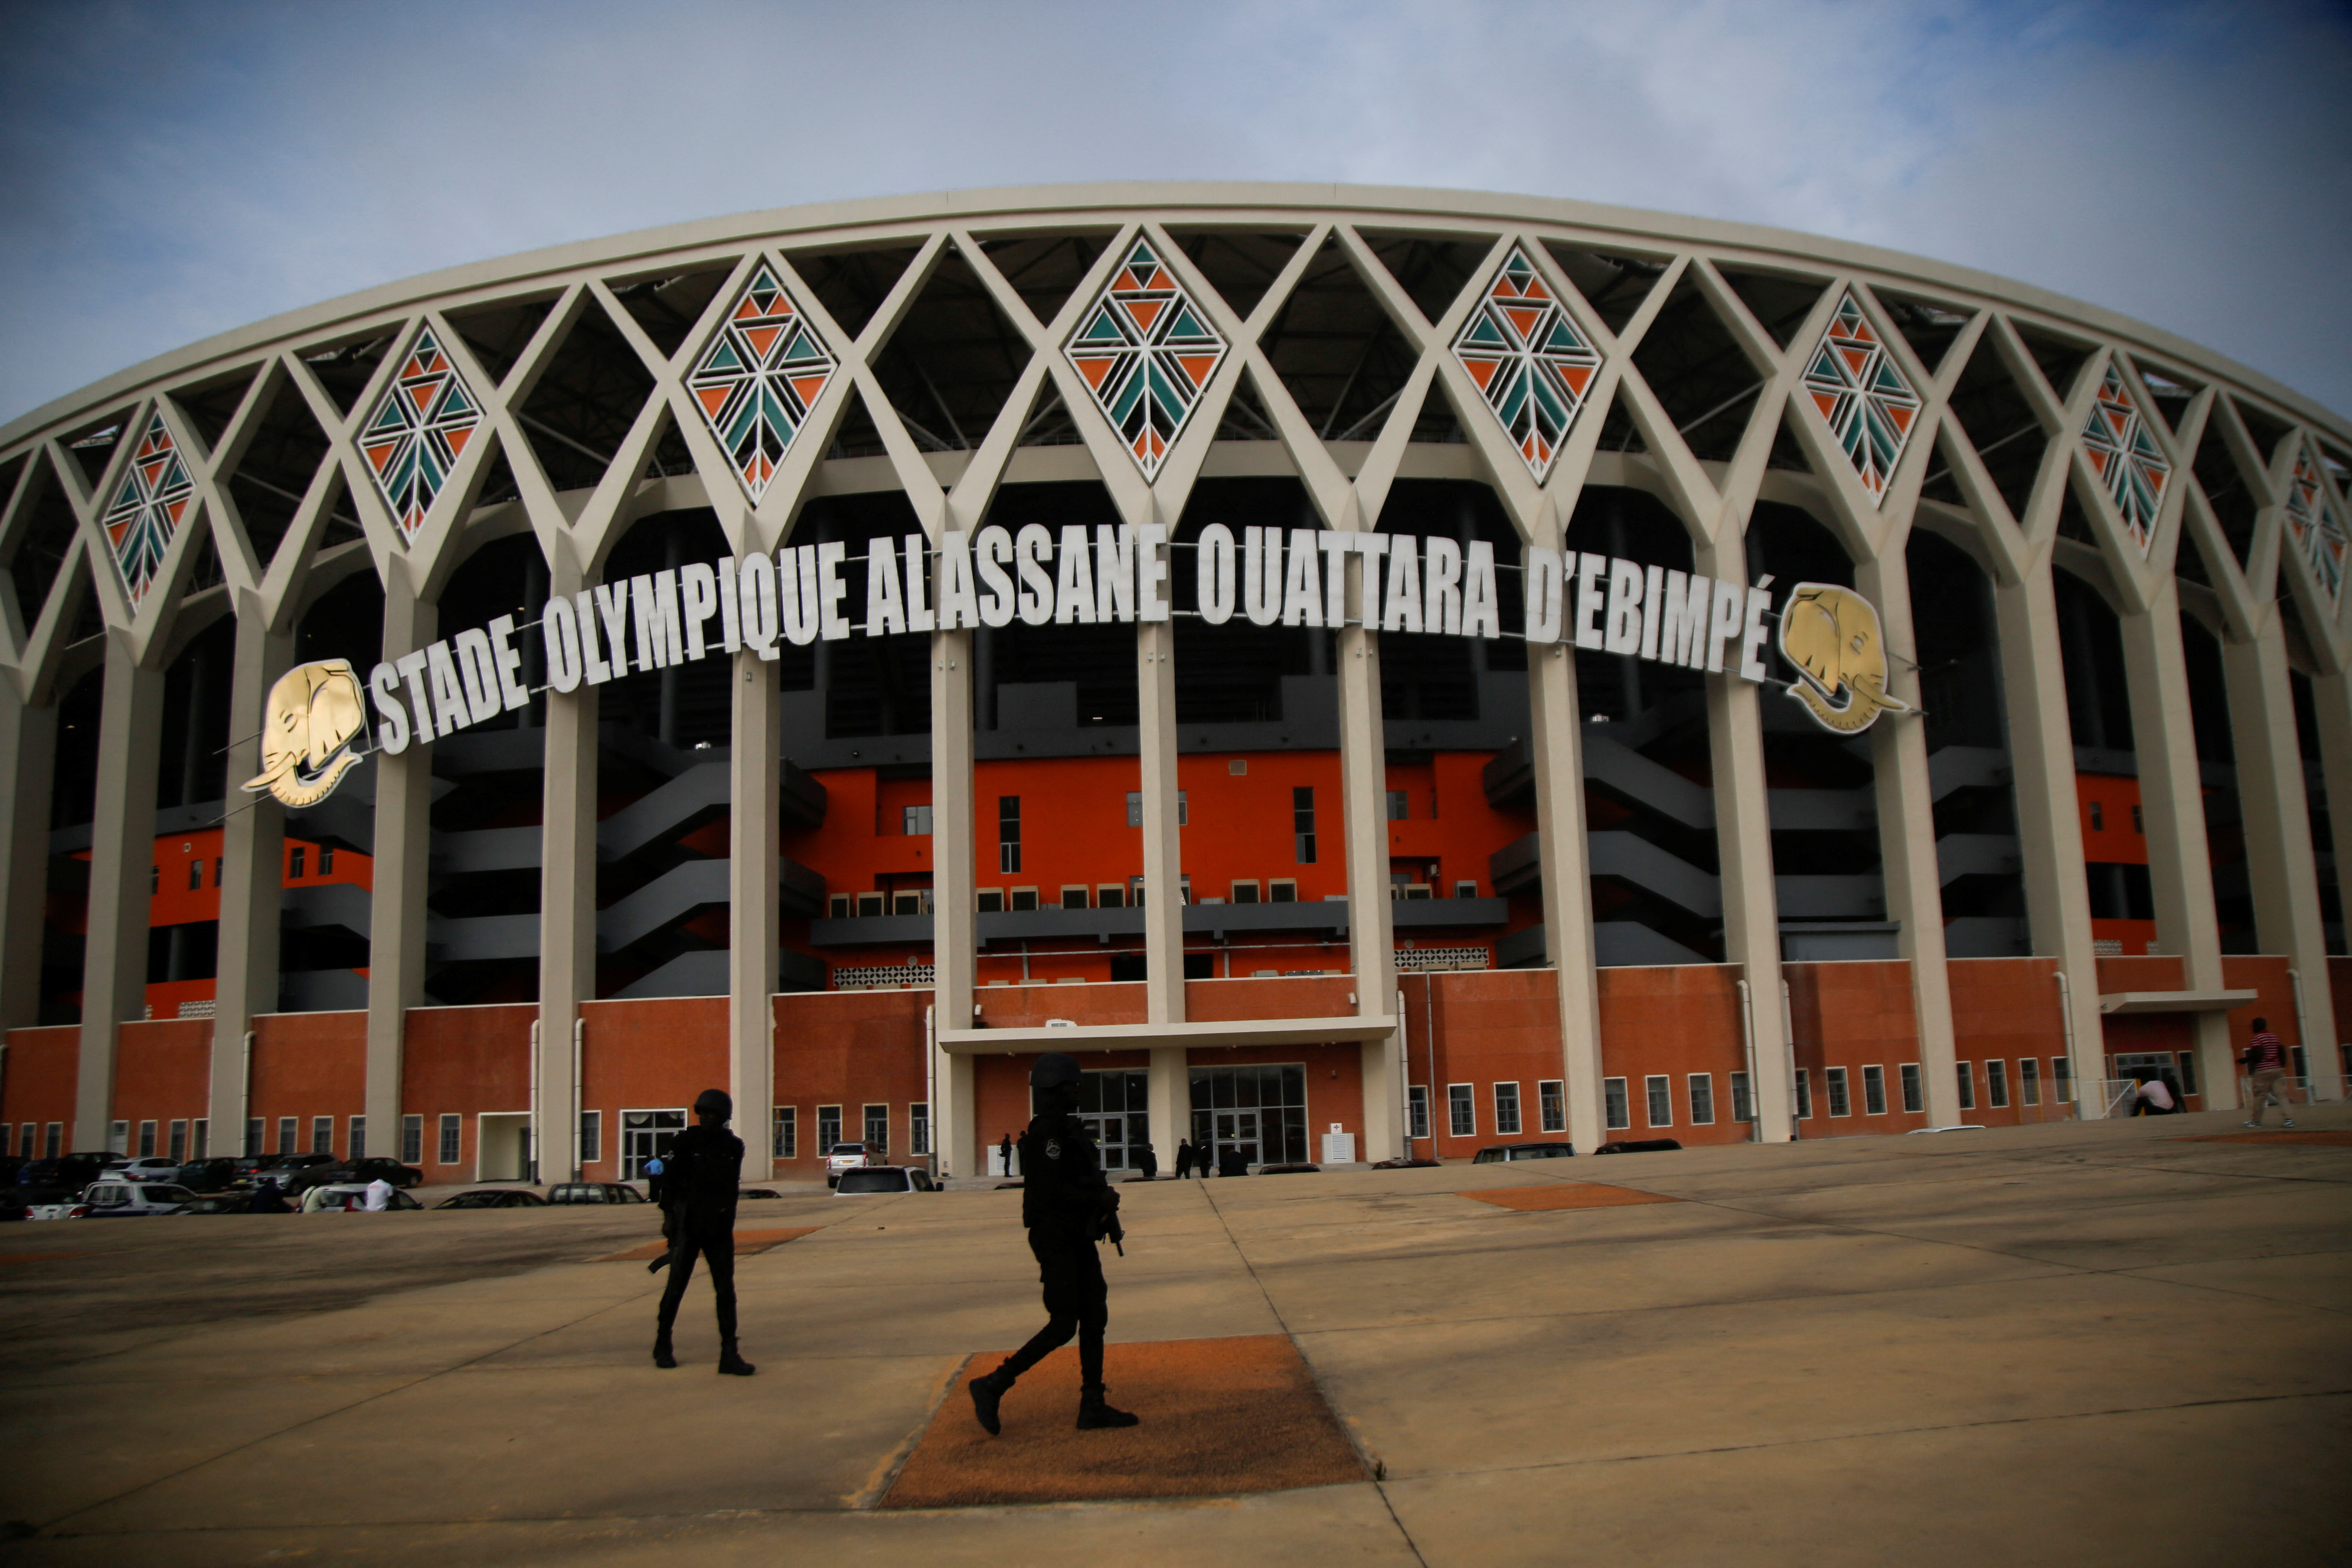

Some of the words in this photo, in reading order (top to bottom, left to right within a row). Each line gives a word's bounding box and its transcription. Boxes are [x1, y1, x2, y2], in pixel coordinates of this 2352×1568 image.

[371, 613, 530, 755] STADE
[543, 541, 850, 693] OLYMPIQUE
[866, 523, 1169, 636] ALASSANE
[1198, 523, 1500, 638] OUATTARA
[1526, 546, 1775, 683] D'EBIMPÉ
